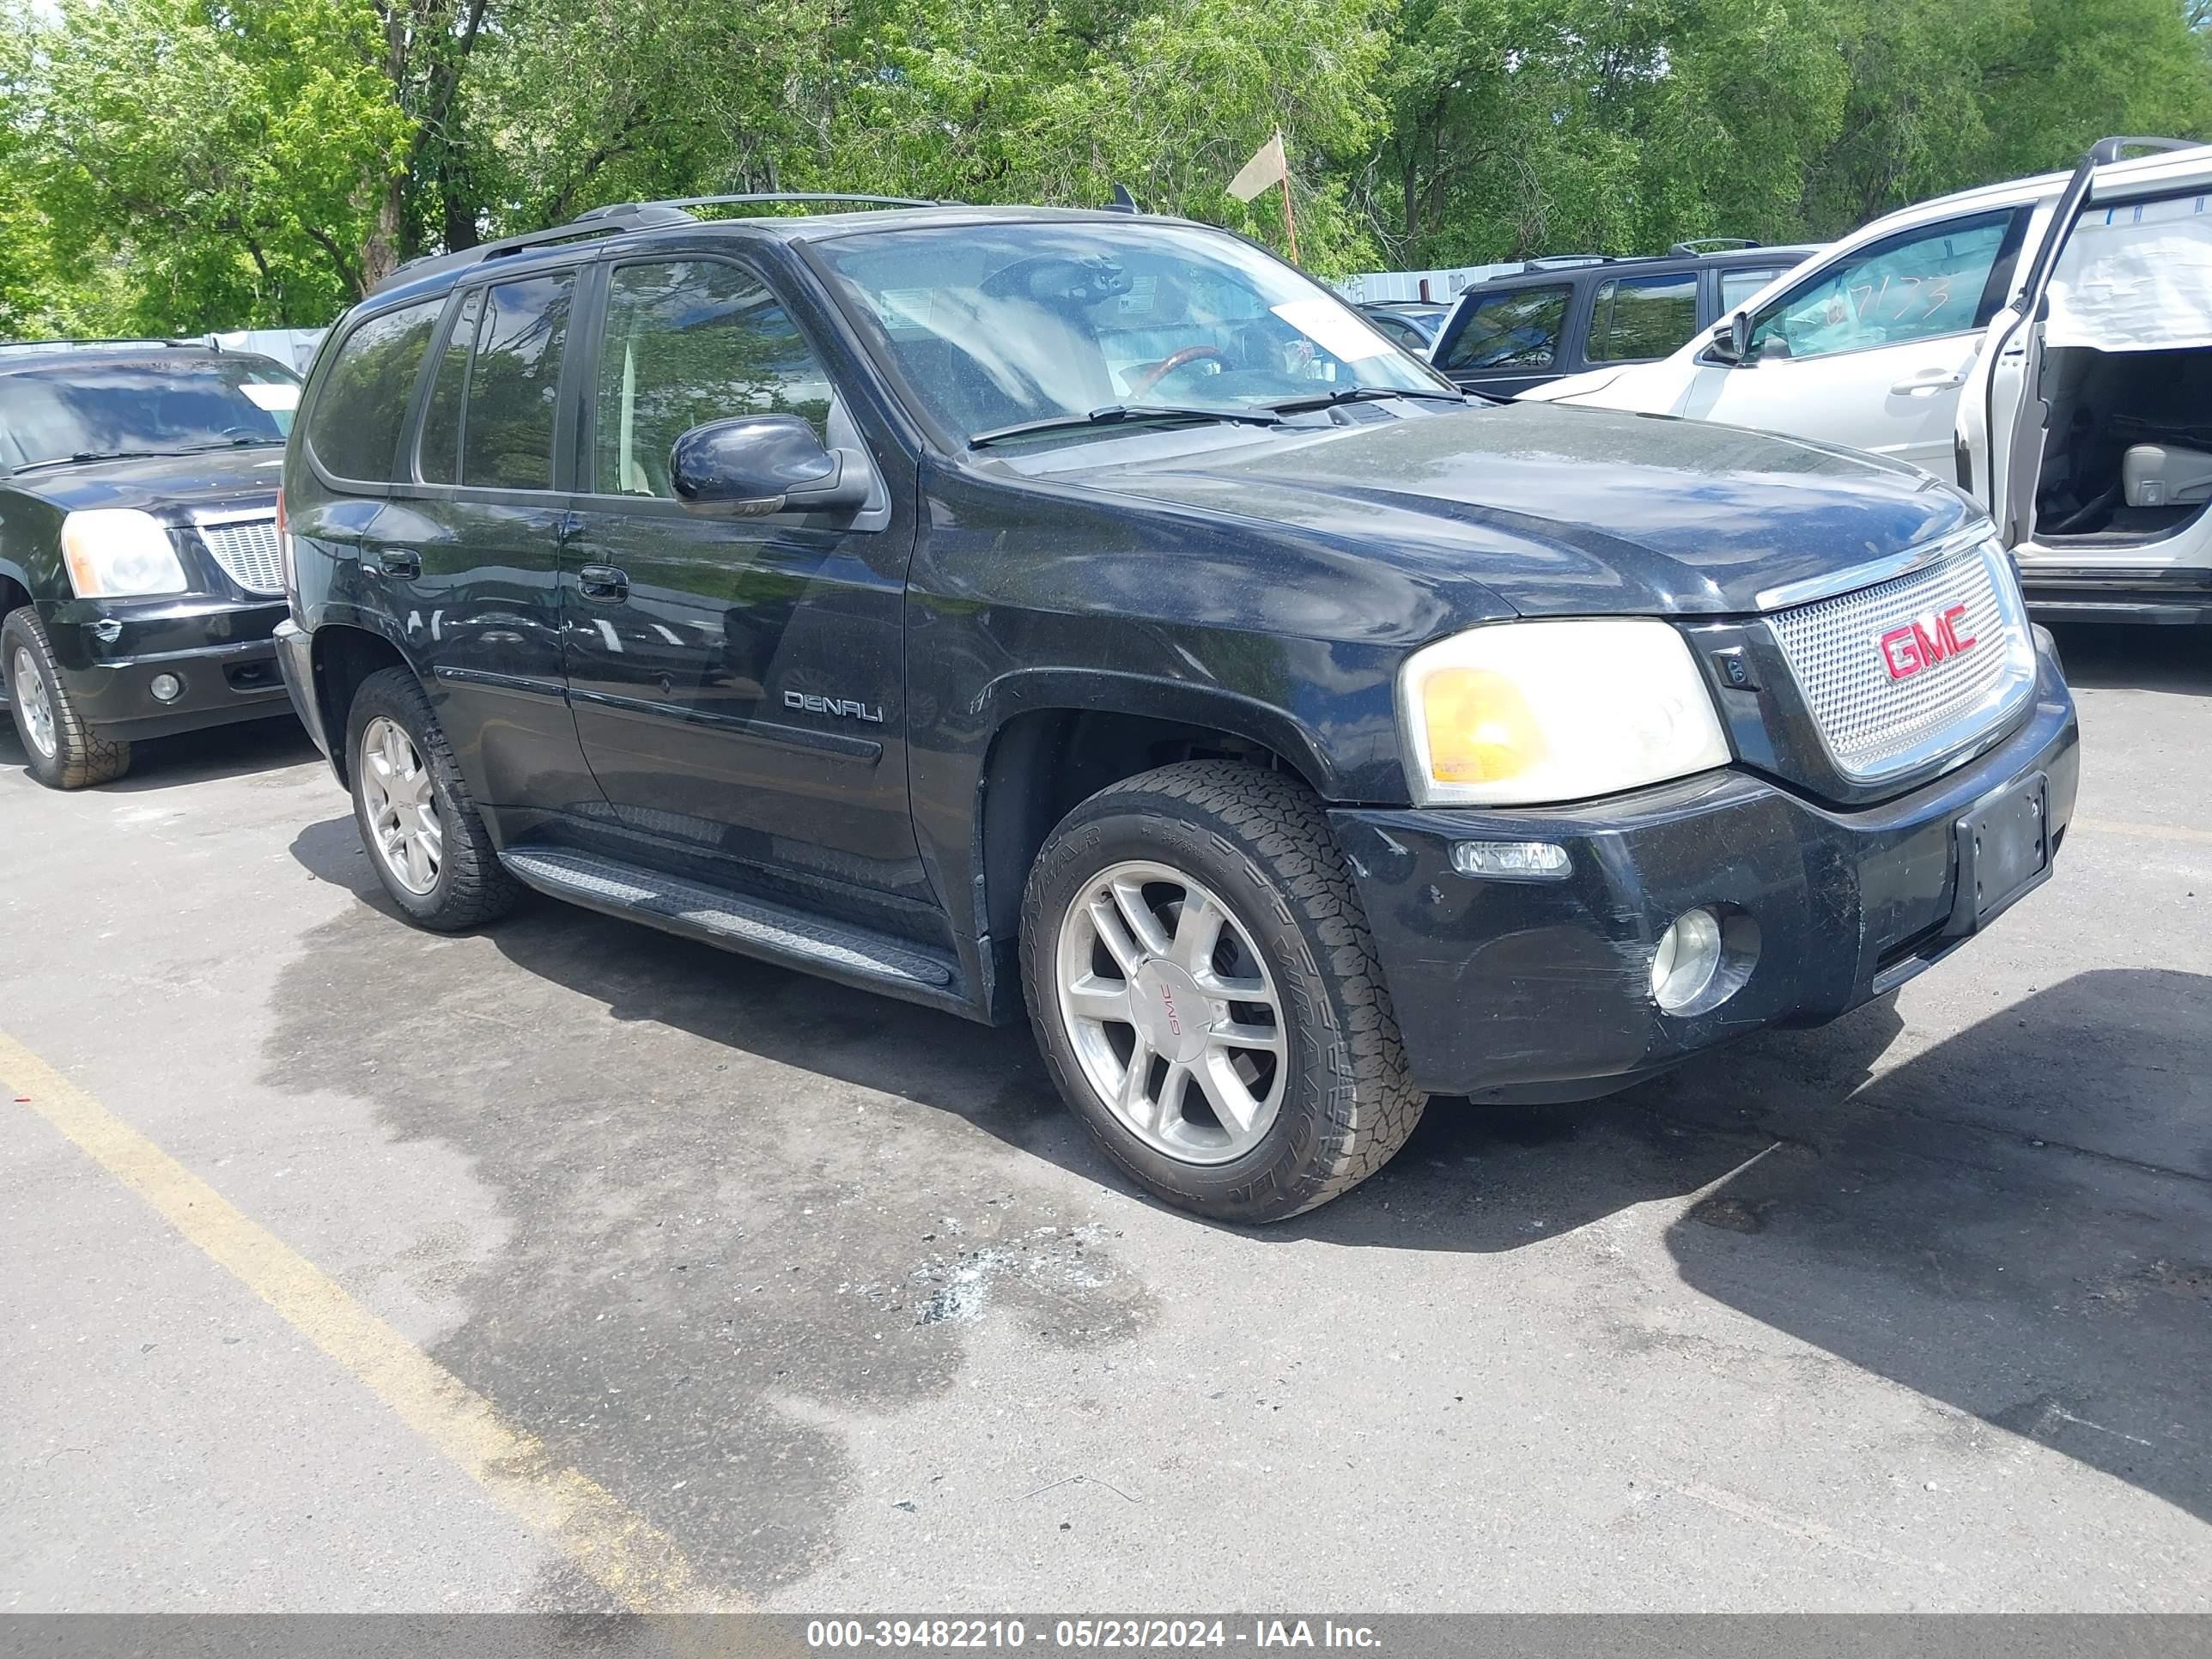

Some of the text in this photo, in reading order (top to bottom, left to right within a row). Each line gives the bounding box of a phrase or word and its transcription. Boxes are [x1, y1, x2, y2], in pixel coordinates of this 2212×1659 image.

[1881, 605, 1978, 679] GMC
[783, 690, 884, 723] DENALI
[1160, 982, 1182, 1036] GMC
